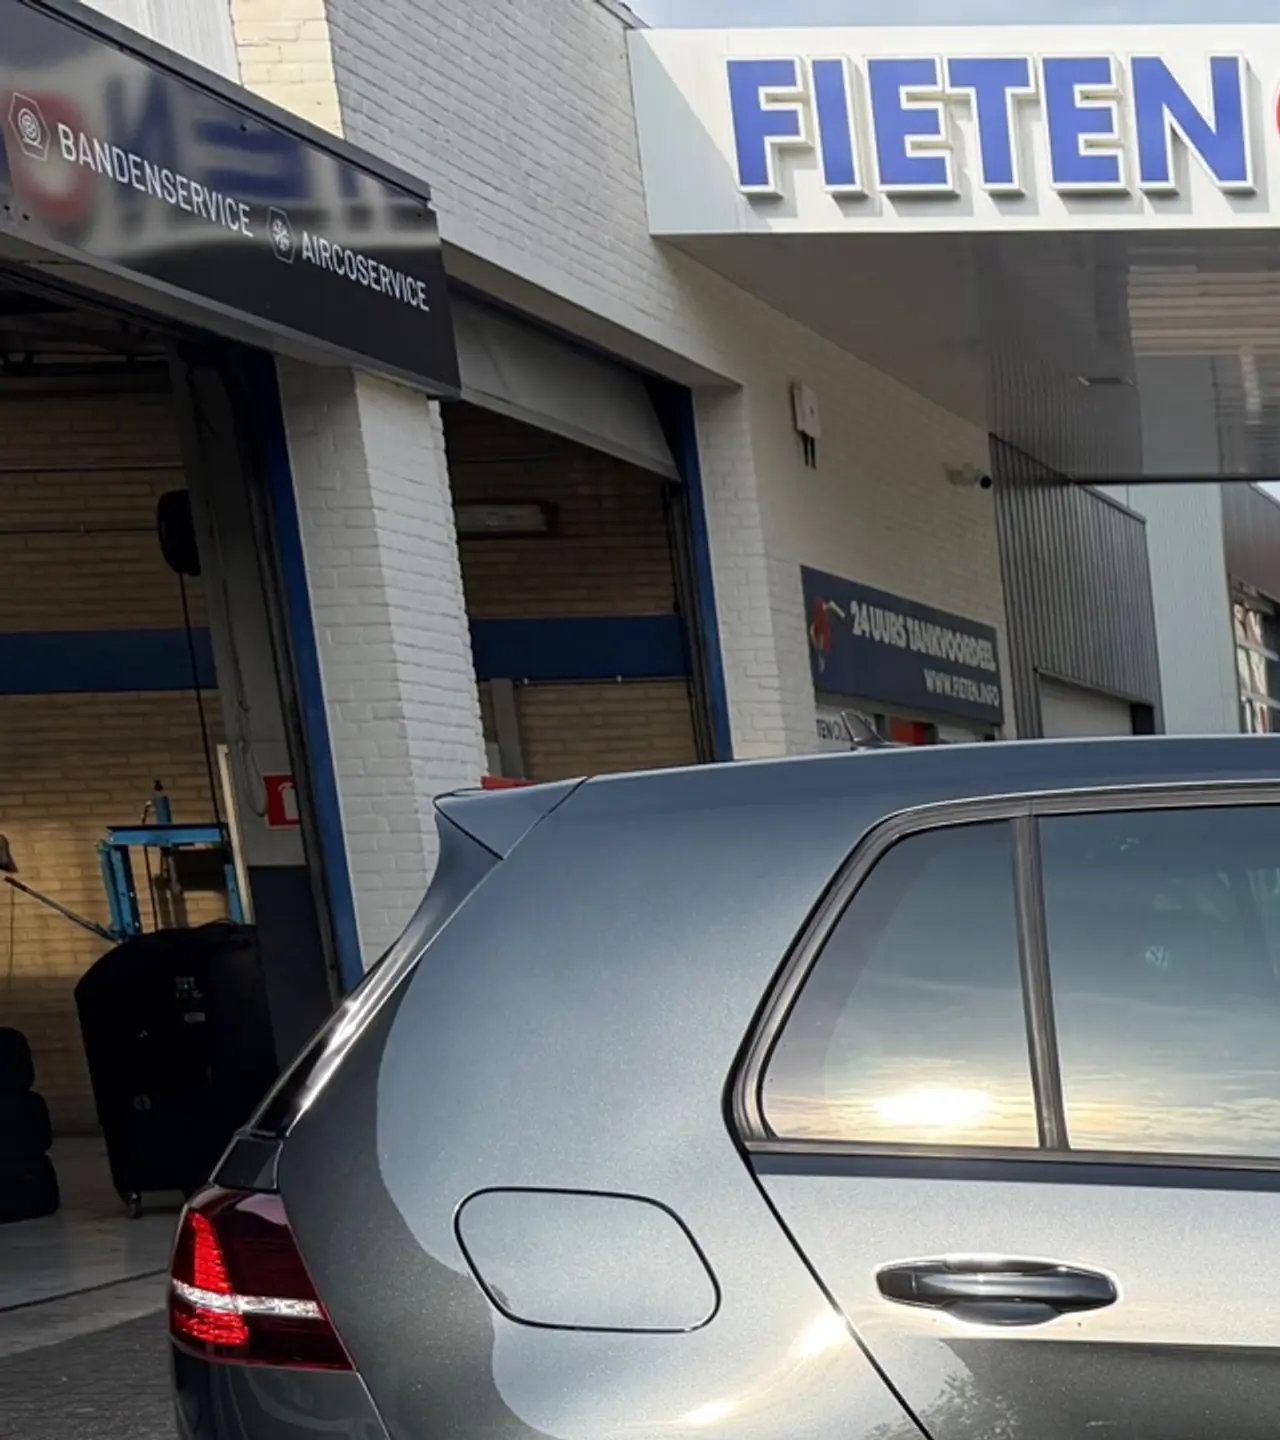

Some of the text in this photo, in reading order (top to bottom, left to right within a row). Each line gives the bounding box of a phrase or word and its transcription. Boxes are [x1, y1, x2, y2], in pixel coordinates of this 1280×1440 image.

[722, 53, 1257, 195] FIETEN
[57, 121, 254, 238] BANDENSERVICE
[301, 230, 430, 312] AIRCOSERVICE
[850, 600, 870, 638] 24
